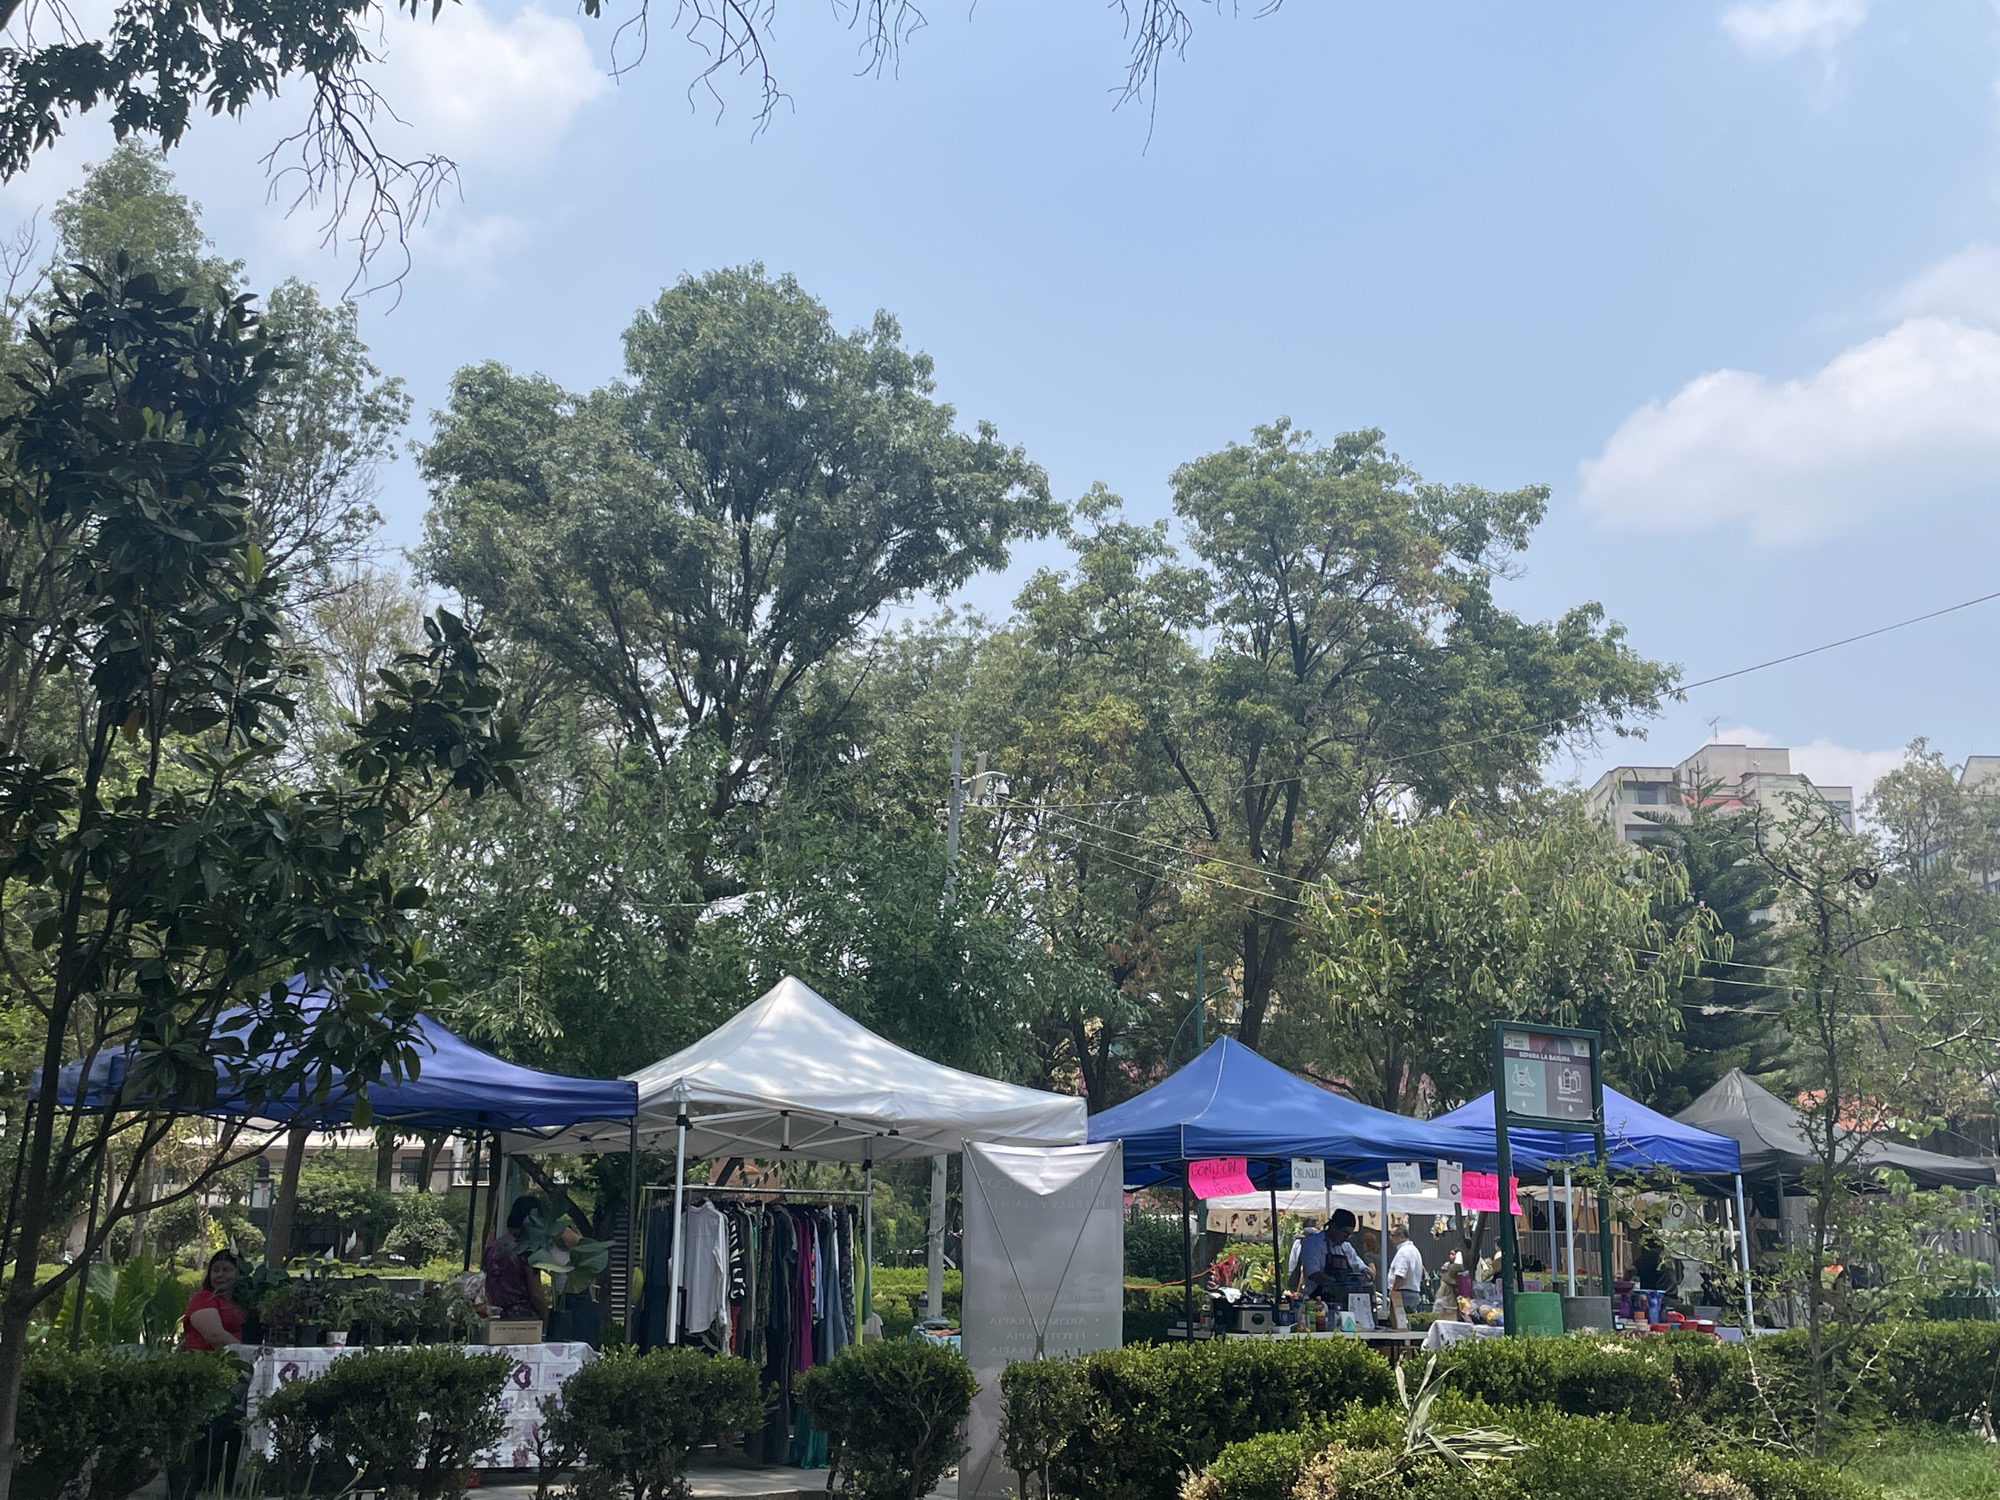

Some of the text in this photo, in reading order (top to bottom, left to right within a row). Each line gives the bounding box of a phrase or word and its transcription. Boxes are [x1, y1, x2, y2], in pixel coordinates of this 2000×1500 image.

[1519, 1051, 1540, 1060] SEPARA
[1540, 1053, 1549, 1061] LA
[1549, 1054, 1571, 1062] BASURA
